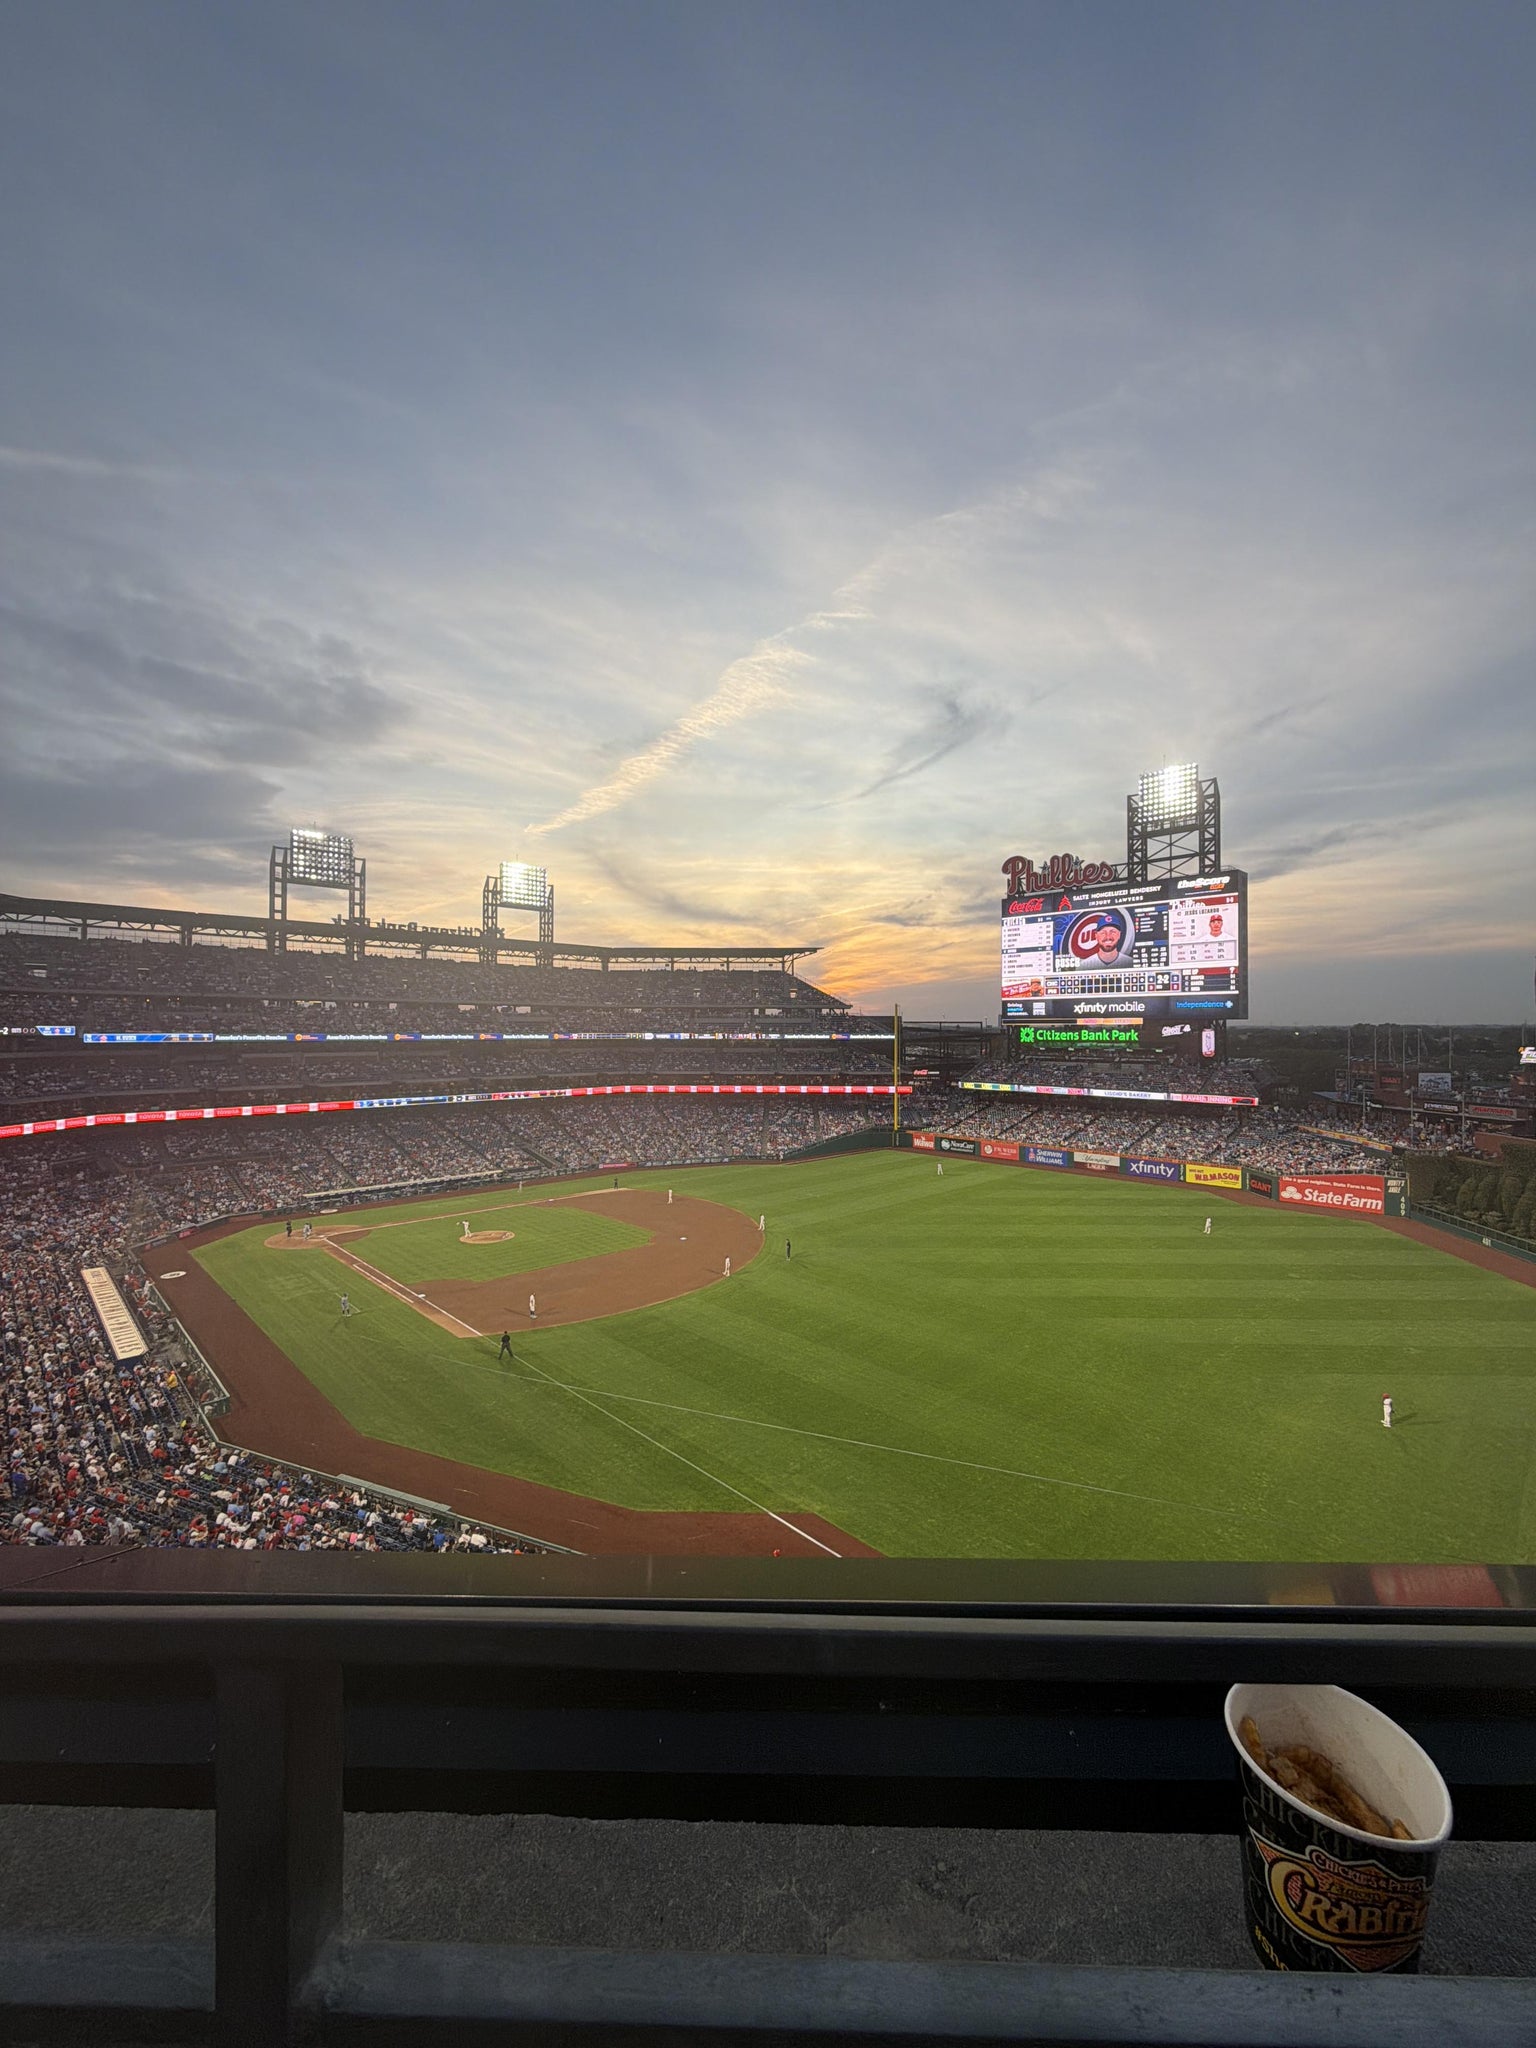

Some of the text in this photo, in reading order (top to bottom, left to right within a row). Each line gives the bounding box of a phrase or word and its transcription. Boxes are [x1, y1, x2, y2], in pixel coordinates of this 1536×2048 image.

[1002, 853, 1114, 895] Phillies
[1074, 1001, 1145, 1014] xfinity mobile
[1176, 1001, 1224, 1009] Independence
[1036, 1029, 1139, 1041] Citizens Bank Park
[914, 1138, 934, 1149] Wawa
[1037, 1149, 1063, 1158] SHERWIN
[1130, 1160, 1174, 1178] xfinity
[1250, 1179, 1271, 1192] GIANT
